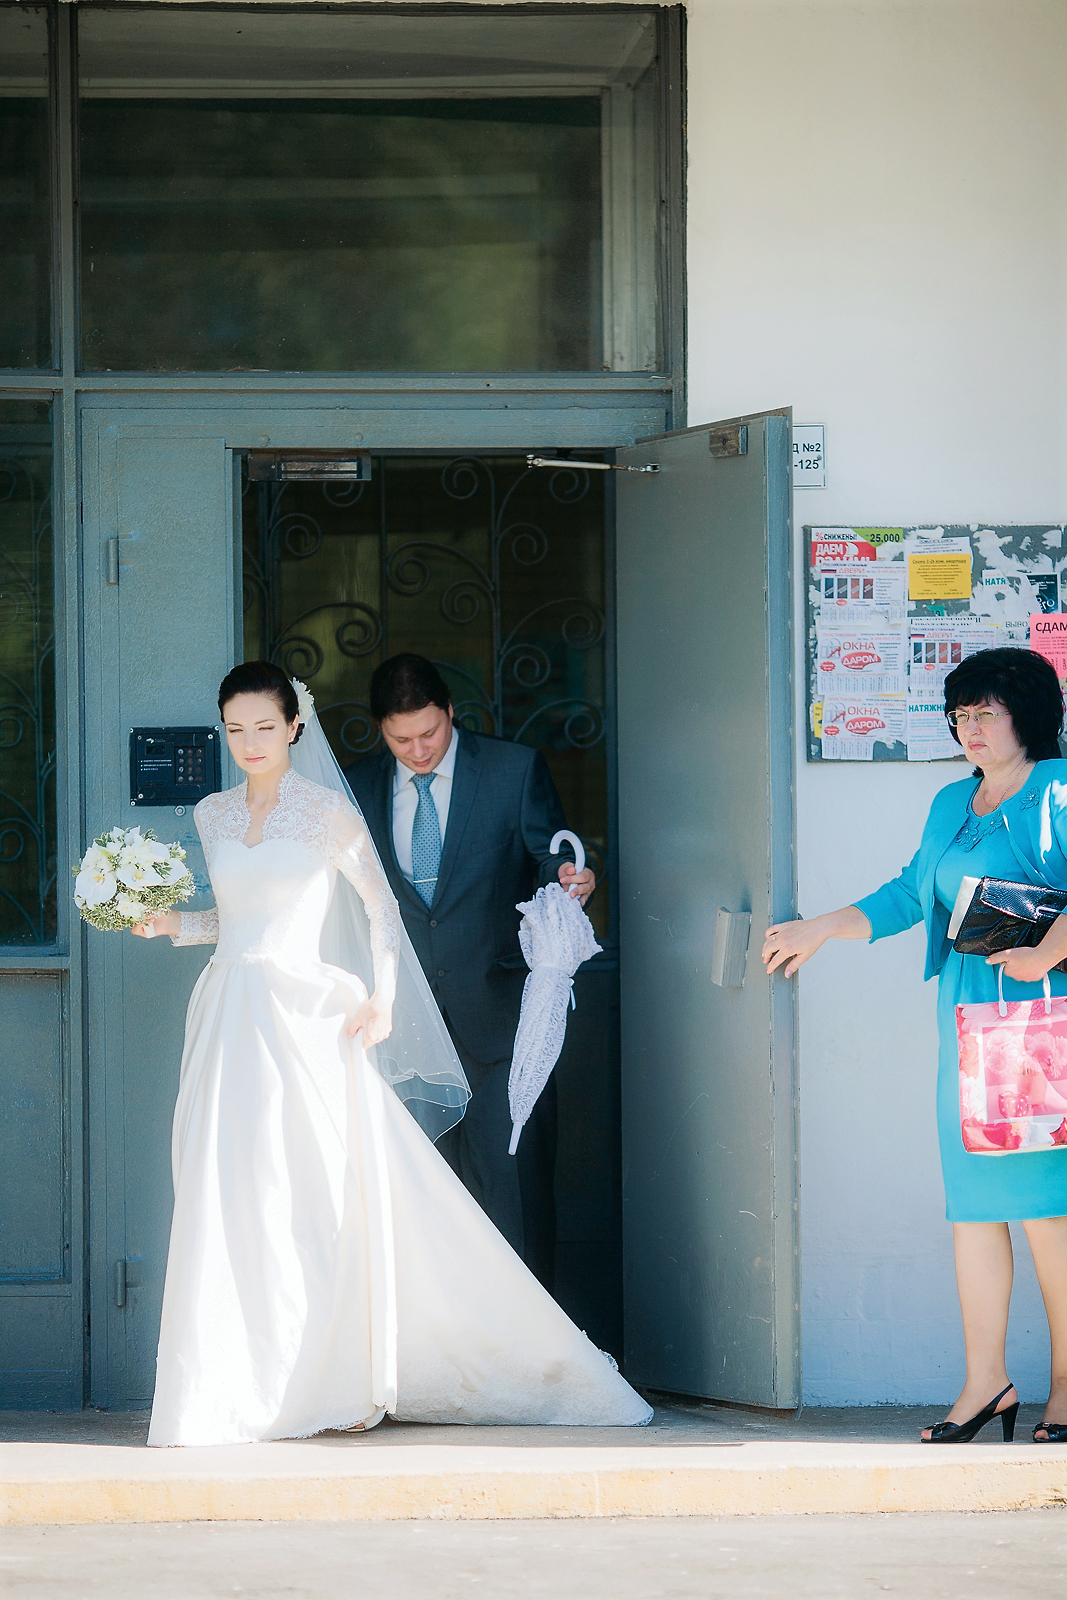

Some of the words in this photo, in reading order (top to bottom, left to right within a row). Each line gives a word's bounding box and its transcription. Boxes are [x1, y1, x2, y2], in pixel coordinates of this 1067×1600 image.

[802, 443, 821, 452] №2
[794, 459, 819, 470] -125
[815, 543, 844, 556] ДАЕМ
[985, 577, 1006, 586] НАТЯ
[842, 641, 876, 651] ОКНА
[843, 654, 879, 665] ДАРОМ
[847, 706, 881, 716] ОКНА
[847, 720, 883, 730] ДАРОМ
